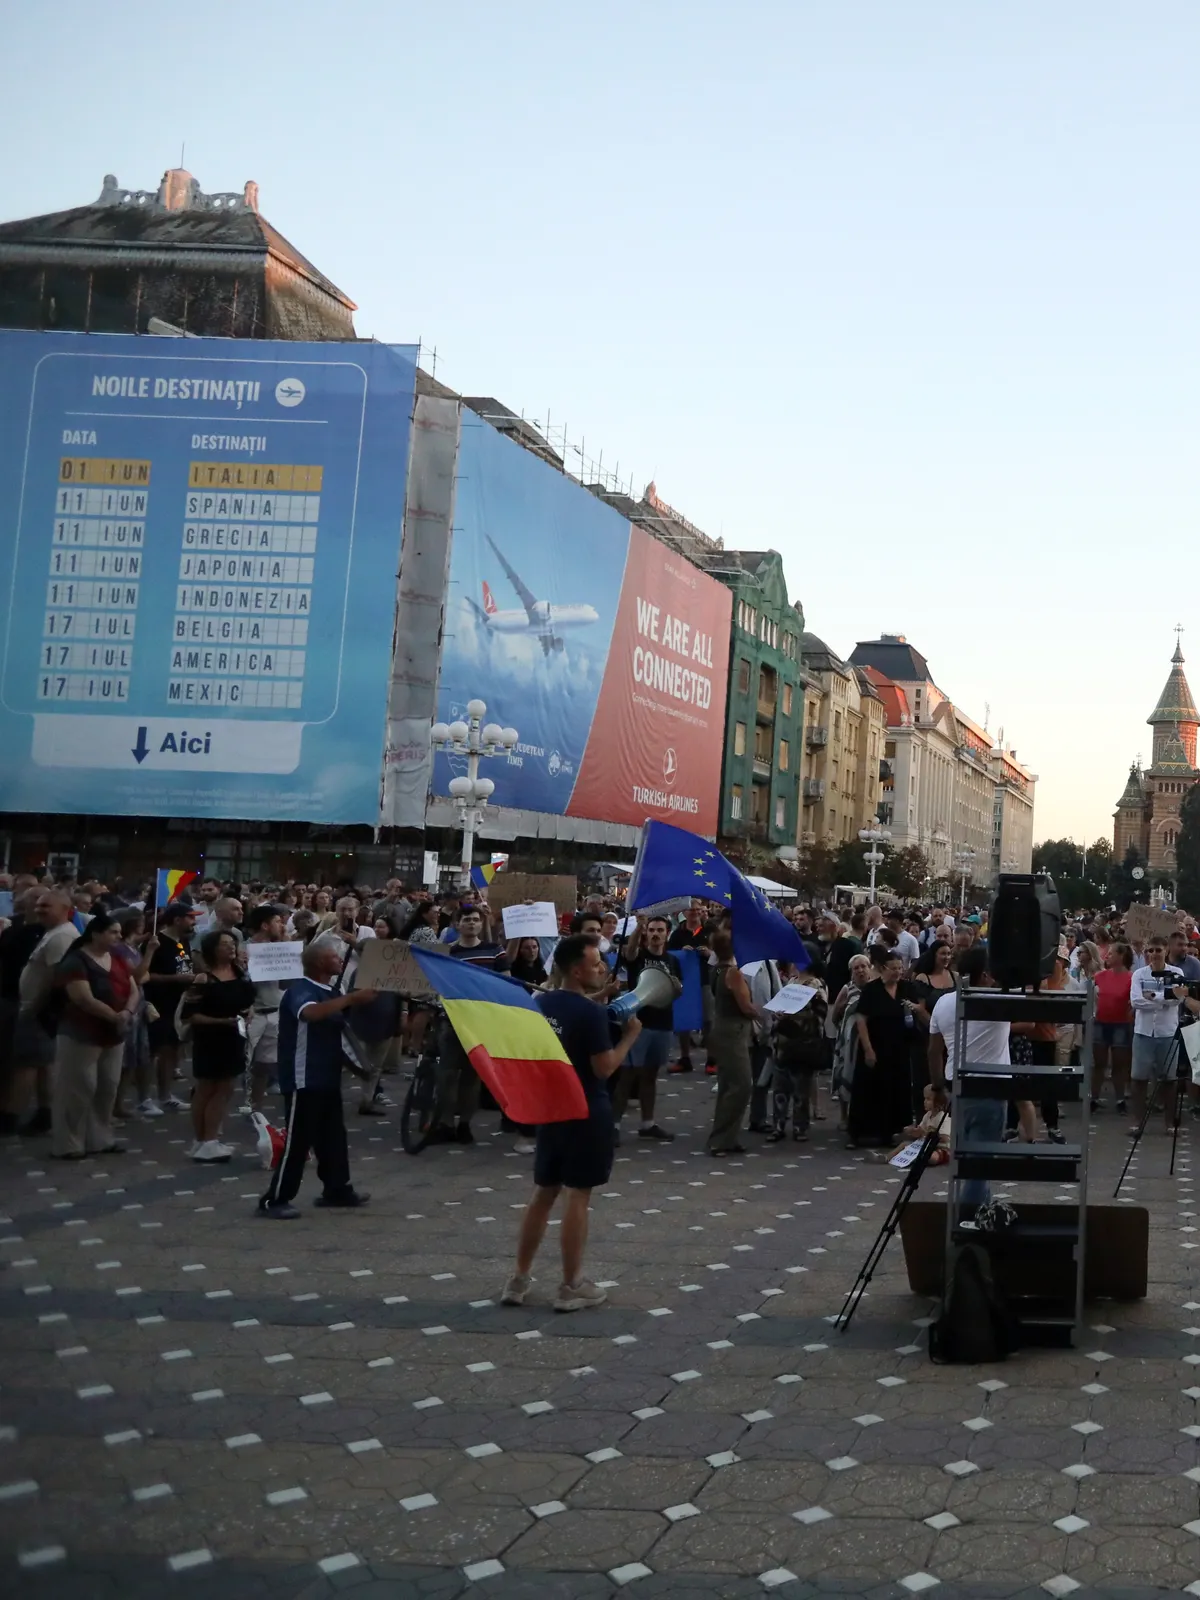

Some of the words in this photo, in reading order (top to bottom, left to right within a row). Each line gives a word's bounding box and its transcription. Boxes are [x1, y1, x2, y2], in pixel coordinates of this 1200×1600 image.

[92, 374, 149, 399] NOILE
[153, 377, 261, 410] DESTINAȚII
[62, 429, 98, 446] DATA
[191, 434, 267, 457] DESTINAȚII
[61, 460, 87, 481] 01
[109, 462, 149, 482] IUN
[193, 466, 276, 486] ITALIA
[61, 490, 83, 512] 11
[107, 492, 145, 512] IUN
[189, 495, 273, 517] SPANIA
[57, 521, 81, 542] 11
[104, 522, 142, 543] IUN
[186, 527, 269, 548] GRECIA
[55, 551, 77, 572] 11
[101, 552, 139, 574] IUN
[184, 557, 282, 578] JAPONIA
[51, 584, 74, 604] 11
[98, 586, 136, 606] IUN
[181, 588, 308, 611] INDONEZIA
[48, 614, 73, 635] 17
[95, 615, 132, 636] IUL
[177, 619, 262, 640] BELGIA
[637, 596, 660, 642] WE
[662, 614, 690, 657] ARE
[691, 630, 714, 669] ALL
[45, 645, 70, 665] 17
[92, 646, 129, 667] IUL
[172, 650, 273, 672] AMERICA
[42, 676, 67, 697] 17
[89, 677, 126, 698] IUL
[633, 646, 711, 710] CONNECTED
[168, 681, 241, 701] MEXIC
[159, 730, 212, 754] Aici
[632, 785, 667, 808] TURKISH
[668, 793, 699, 814] AIRLINES
